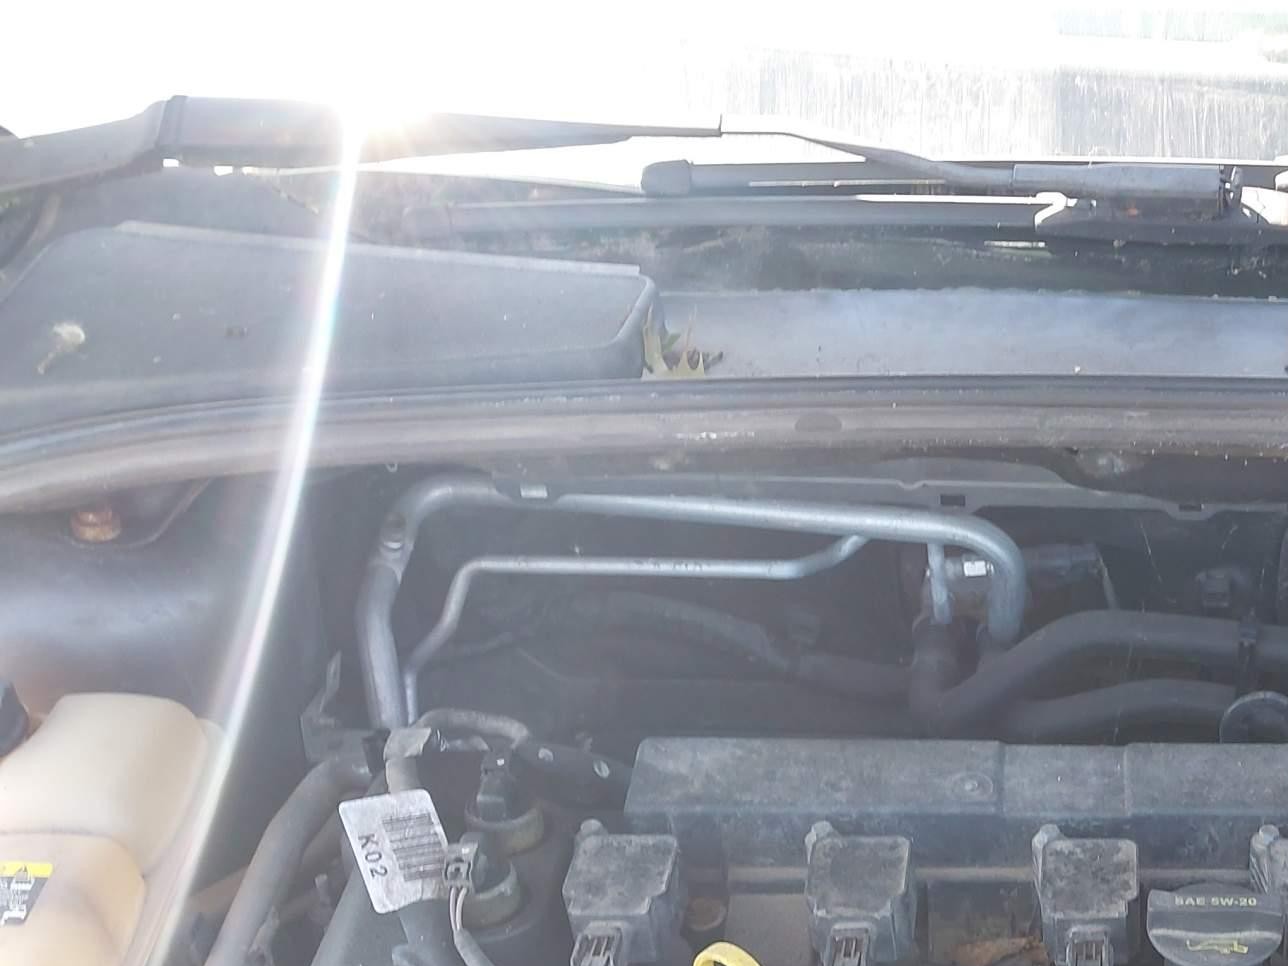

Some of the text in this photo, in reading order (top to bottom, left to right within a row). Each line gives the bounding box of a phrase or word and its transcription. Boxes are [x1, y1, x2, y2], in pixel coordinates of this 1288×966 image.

[357, 833, 388, 878] K02
[1174, 895, 1257, 907] SAE 5W-20
